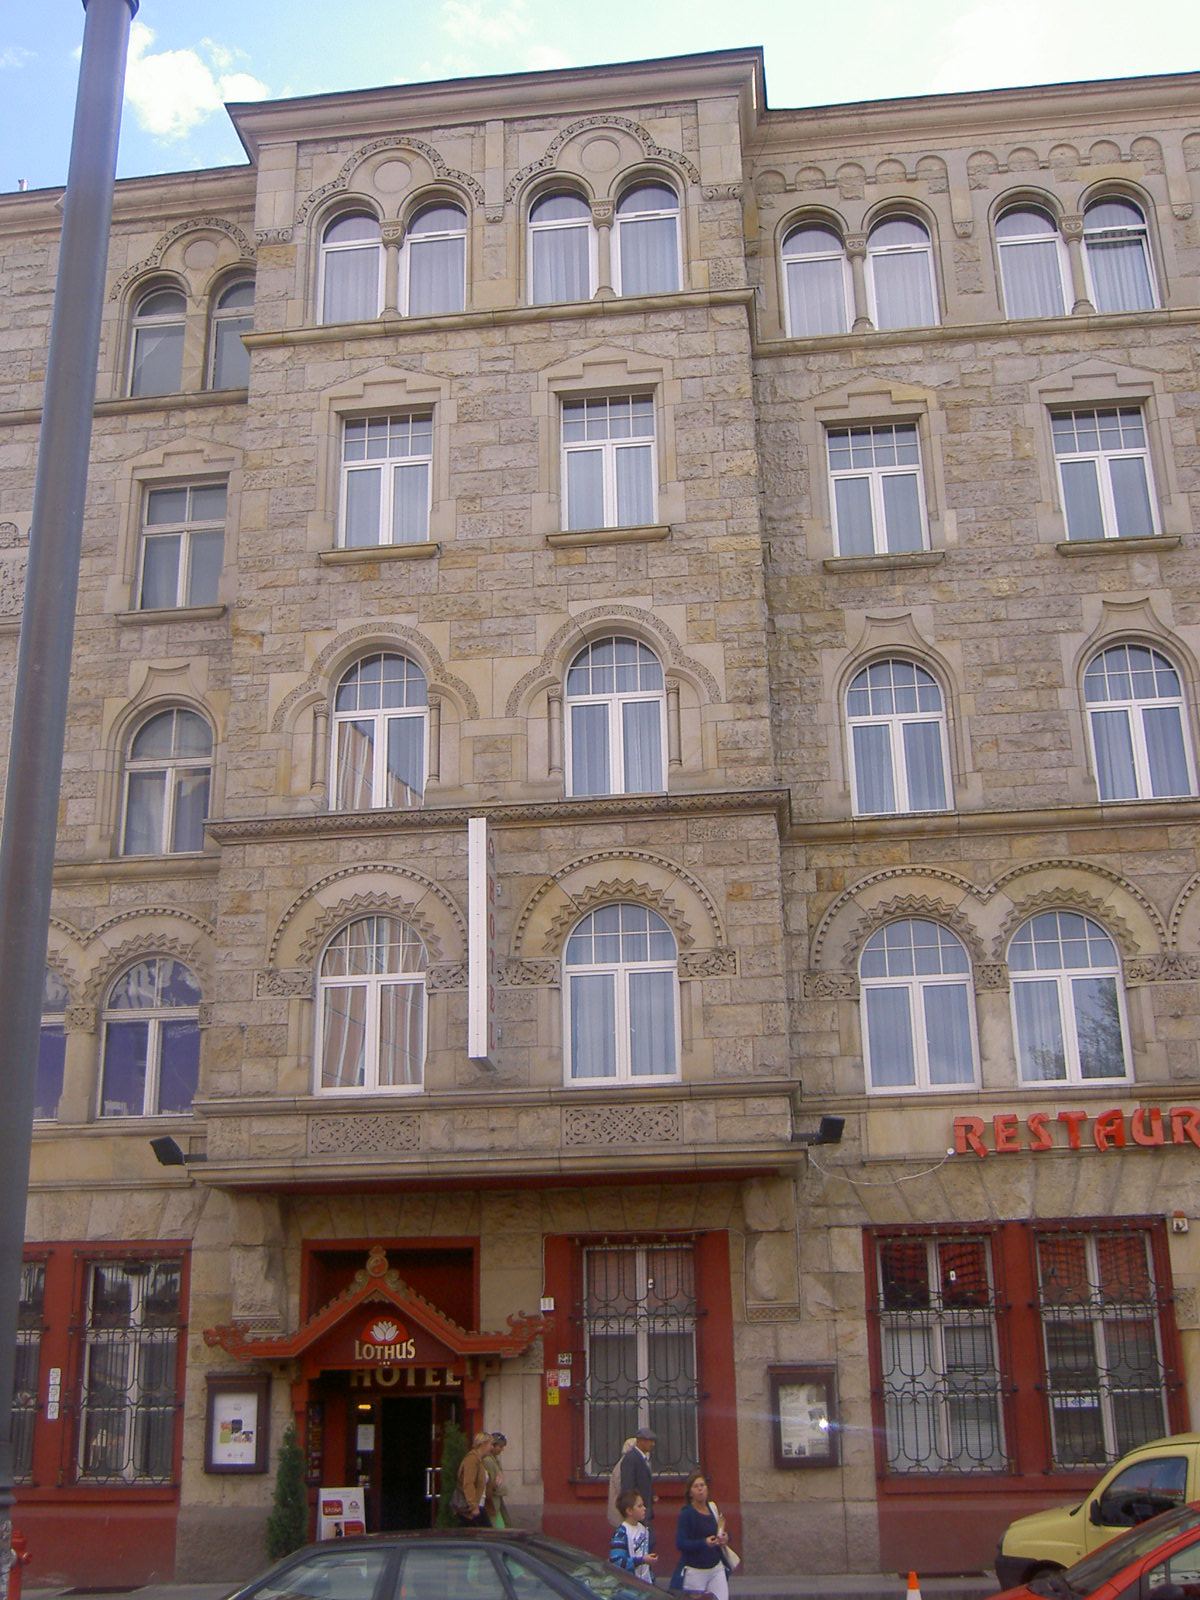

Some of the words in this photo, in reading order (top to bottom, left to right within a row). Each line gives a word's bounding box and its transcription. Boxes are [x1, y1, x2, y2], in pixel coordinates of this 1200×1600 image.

[953, 1107, 1200, 1157] RESTAUR
[354, 1338, 416, 1360] LOTHUS
[351, 1366, 461, 1386] HOTEL
